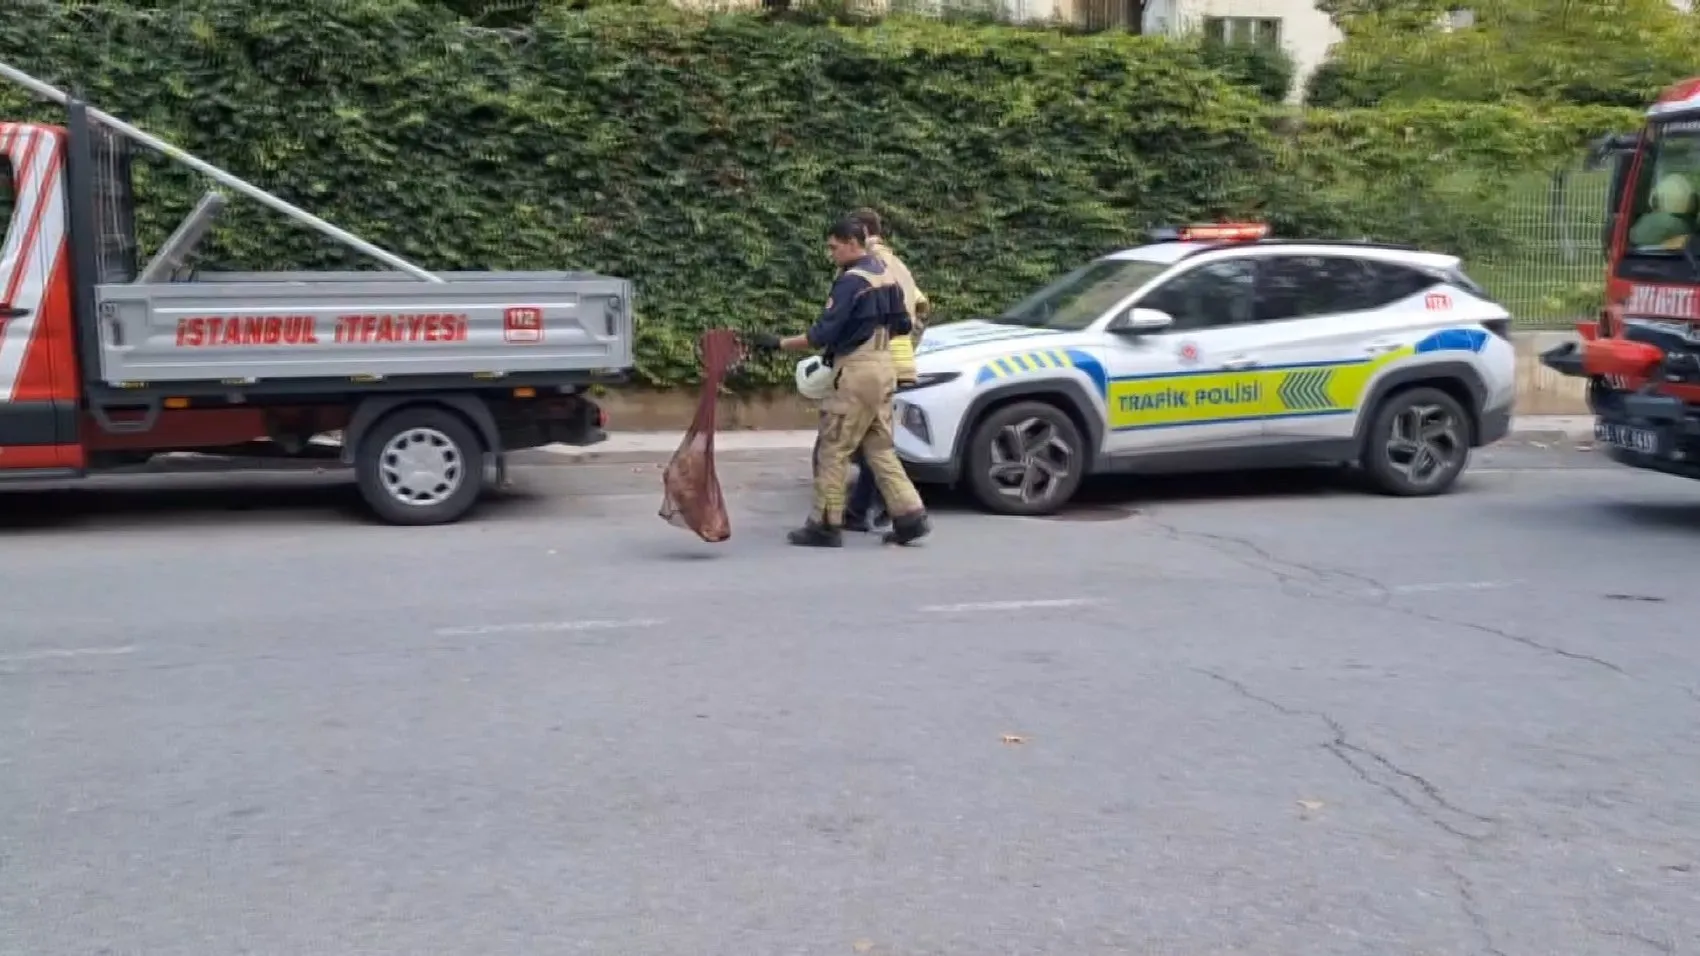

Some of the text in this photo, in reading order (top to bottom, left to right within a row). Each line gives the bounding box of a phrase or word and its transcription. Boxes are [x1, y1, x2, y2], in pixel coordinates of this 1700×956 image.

[176, 312, 468, 346] İSTANBUL İTFAİYESİ
[510, 310, 536, 326] 112
[1118, 380, 1262, 412] TRAFİK POLİSİ
